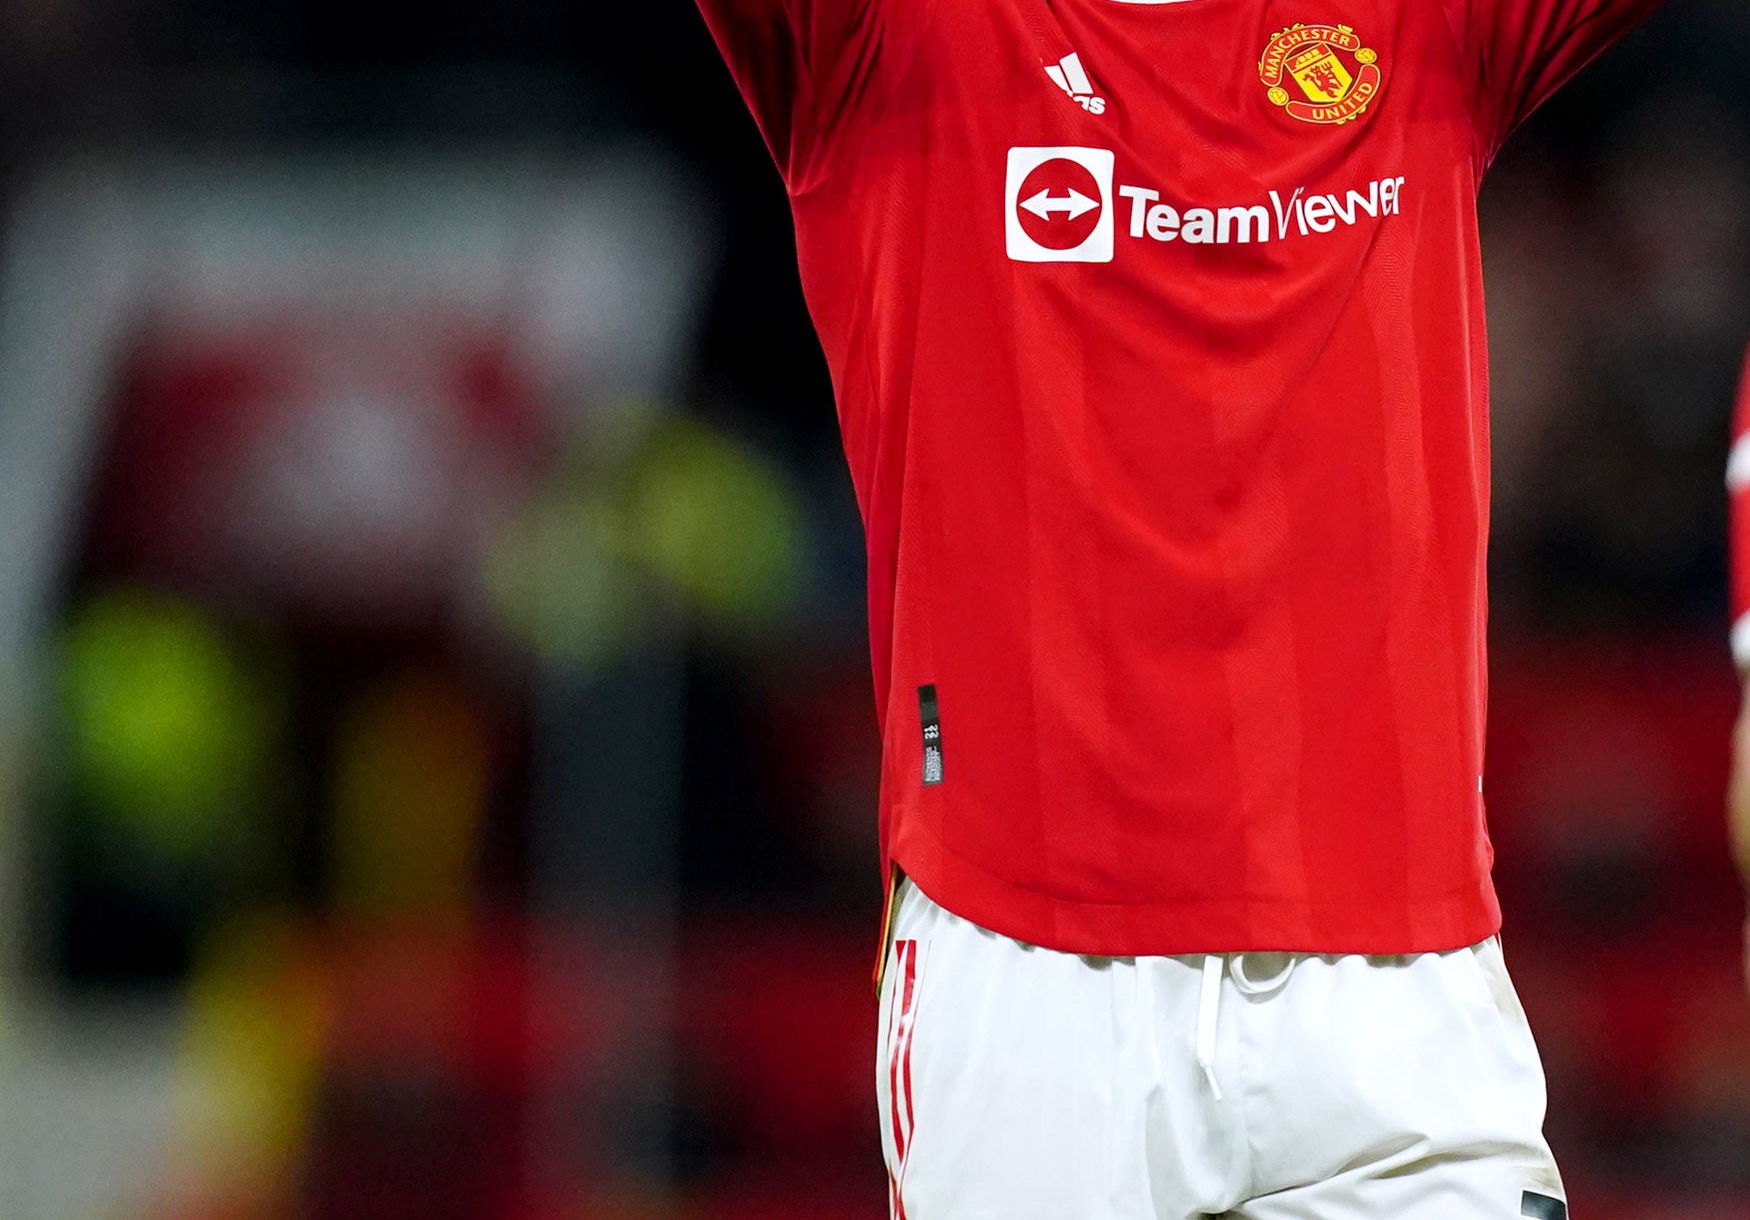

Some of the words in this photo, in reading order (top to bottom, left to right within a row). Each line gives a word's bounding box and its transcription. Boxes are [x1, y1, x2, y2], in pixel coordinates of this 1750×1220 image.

[1264, 29, 1351, 78] MANCHESTER
[1312, 83, 1373, 120] UNITED
[1119, 176, 1405, 244] TeamViewer
